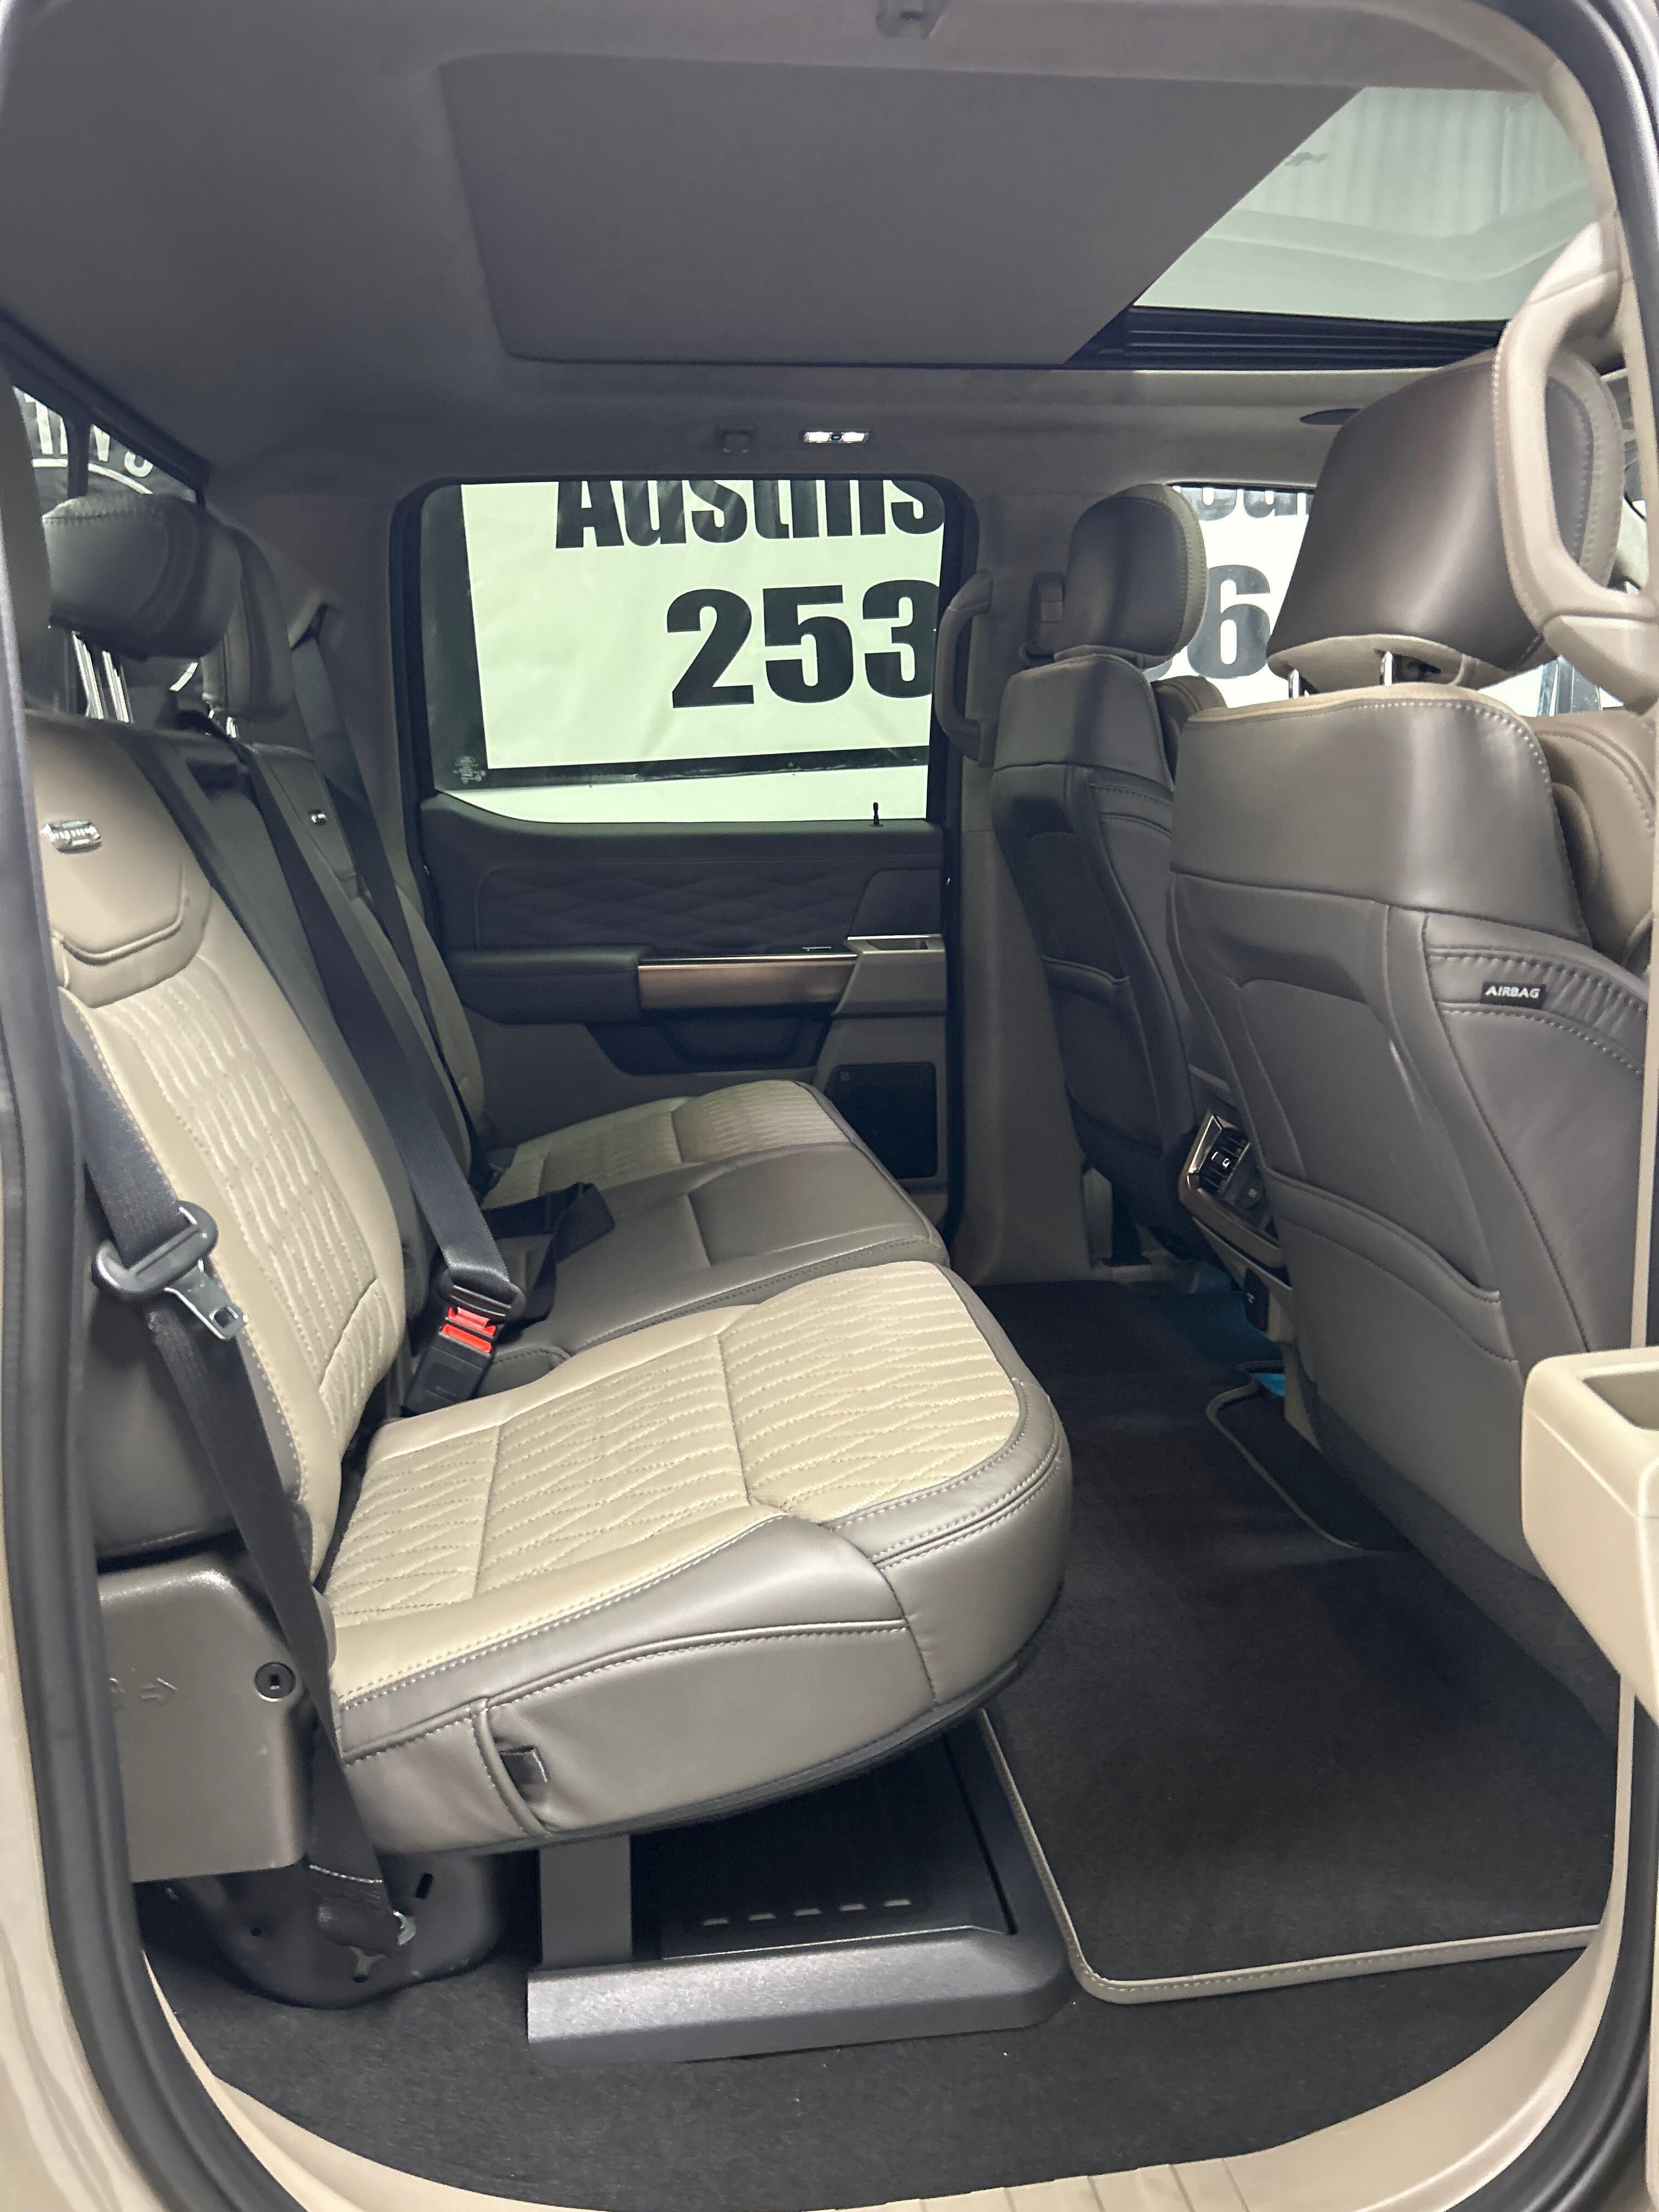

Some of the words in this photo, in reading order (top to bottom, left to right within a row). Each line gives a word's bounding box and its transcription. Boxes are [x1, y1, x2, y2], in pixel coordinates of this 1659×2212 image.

[667, 579, 939, 708] 253
[1141, 565, 1271, 682] 6
[1485, 986, 1541, 999] AIRBAG
